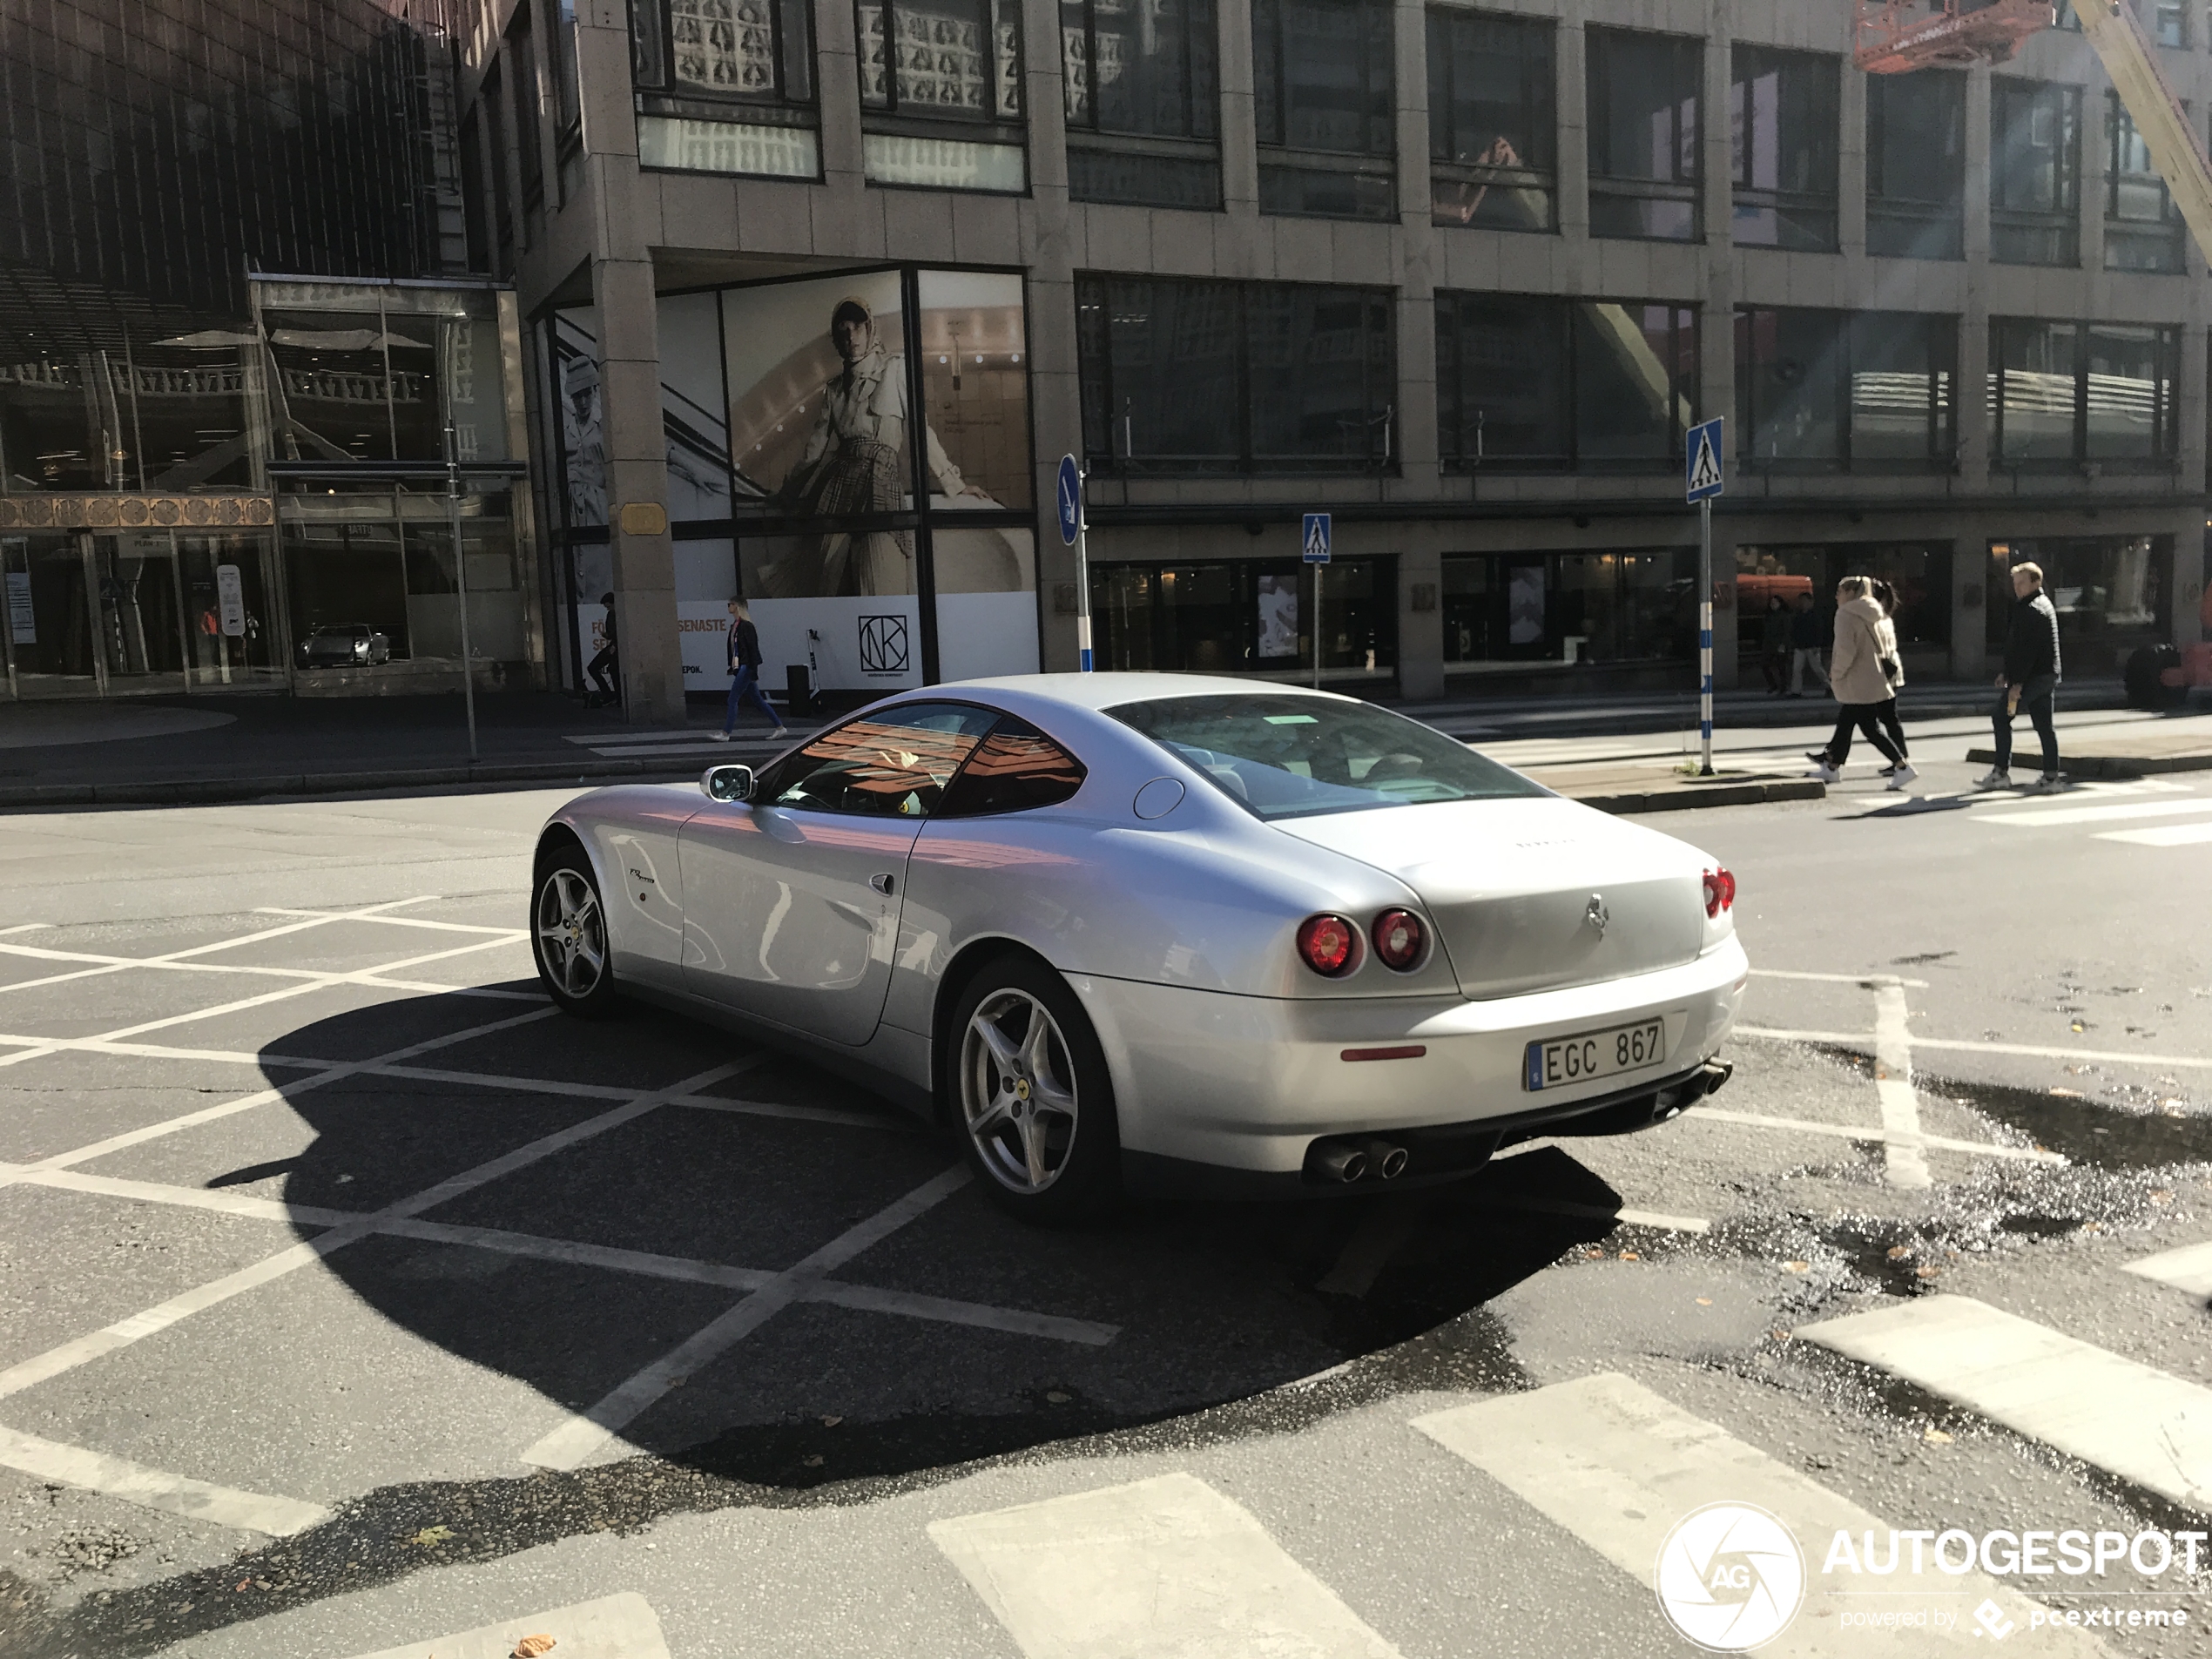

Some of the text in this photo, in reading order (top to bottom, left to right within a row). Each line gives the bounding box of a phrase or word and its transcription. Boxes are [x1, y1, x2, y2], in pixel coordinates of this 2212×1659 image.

[592, 618, 726, 634] FÖ SENASTE
[1547, 1026, 1658, 1082] EGC 867
[1533, 1072, 1539, 1082] S
